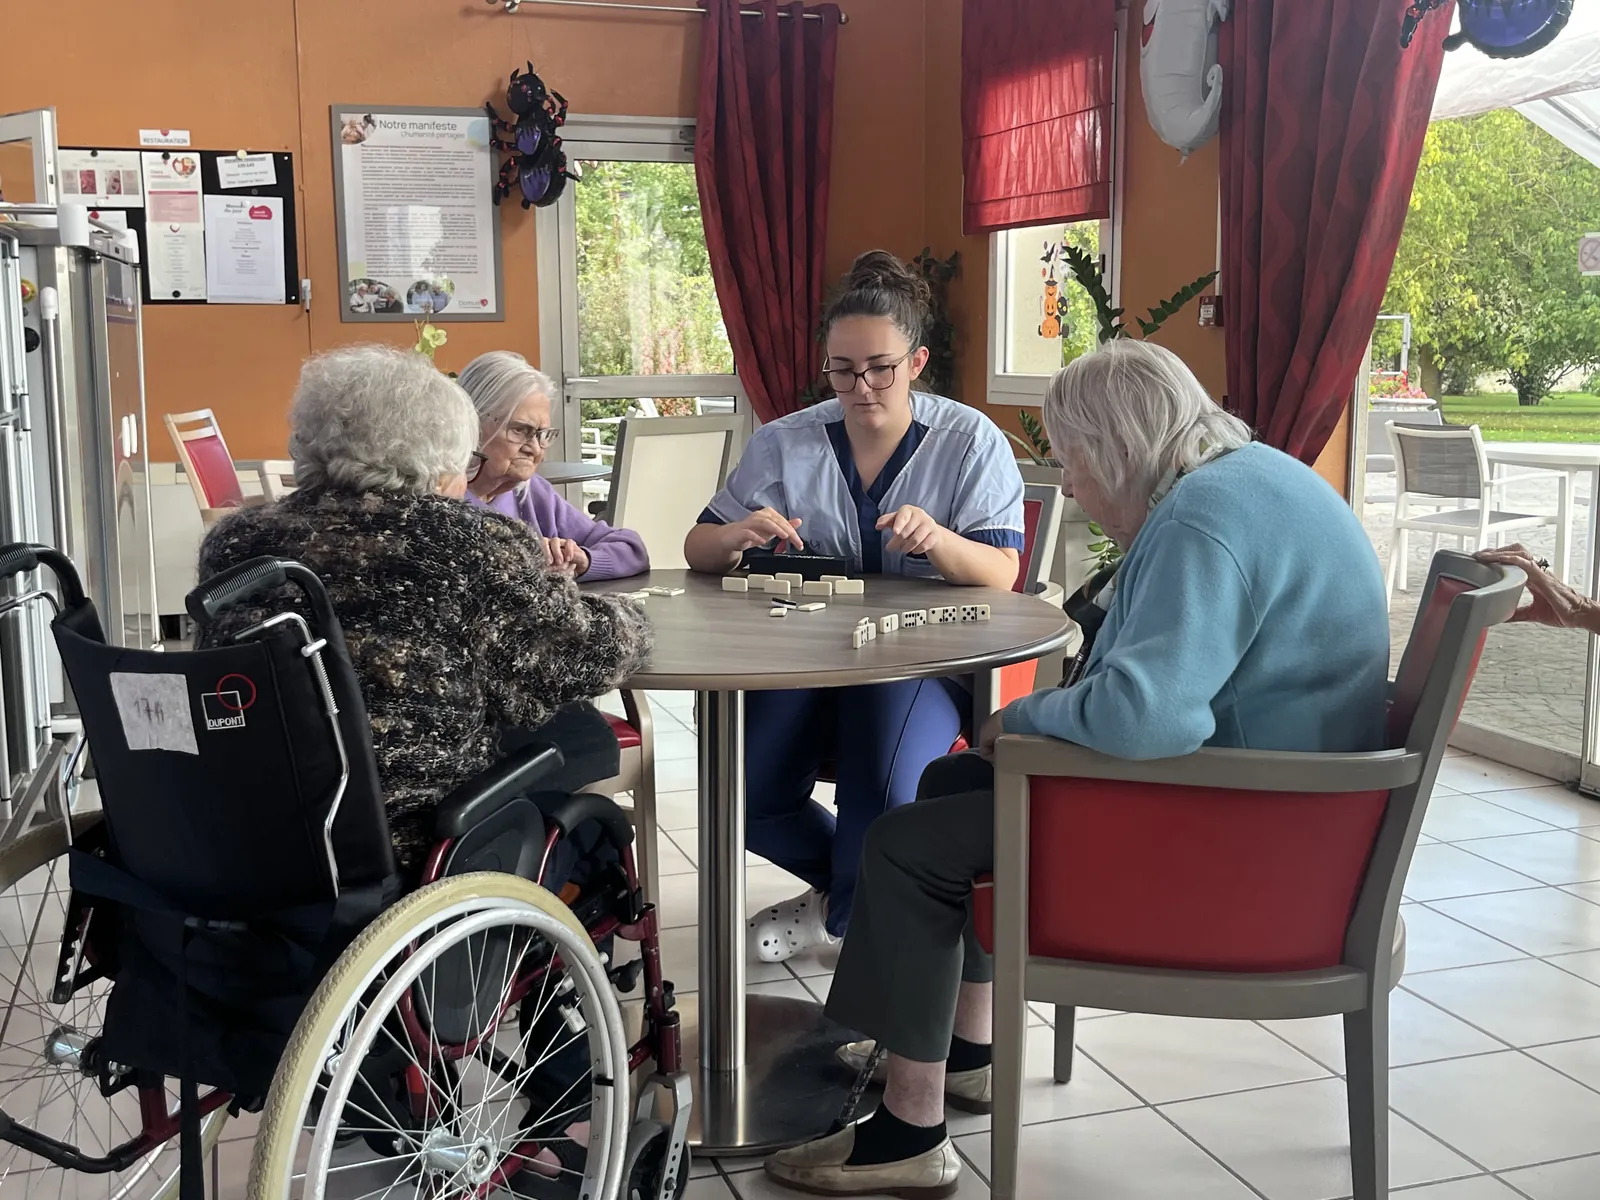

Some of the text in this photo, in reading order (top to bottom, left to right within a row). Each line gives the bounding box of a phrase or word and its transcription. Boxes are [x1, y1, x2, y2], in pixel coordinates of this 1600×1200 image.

[379, 120, 457, 131] Notre manifeste
[143, 137, 188, 145] RESTAURATION
[208, 715, 244, 728] DUPONT
